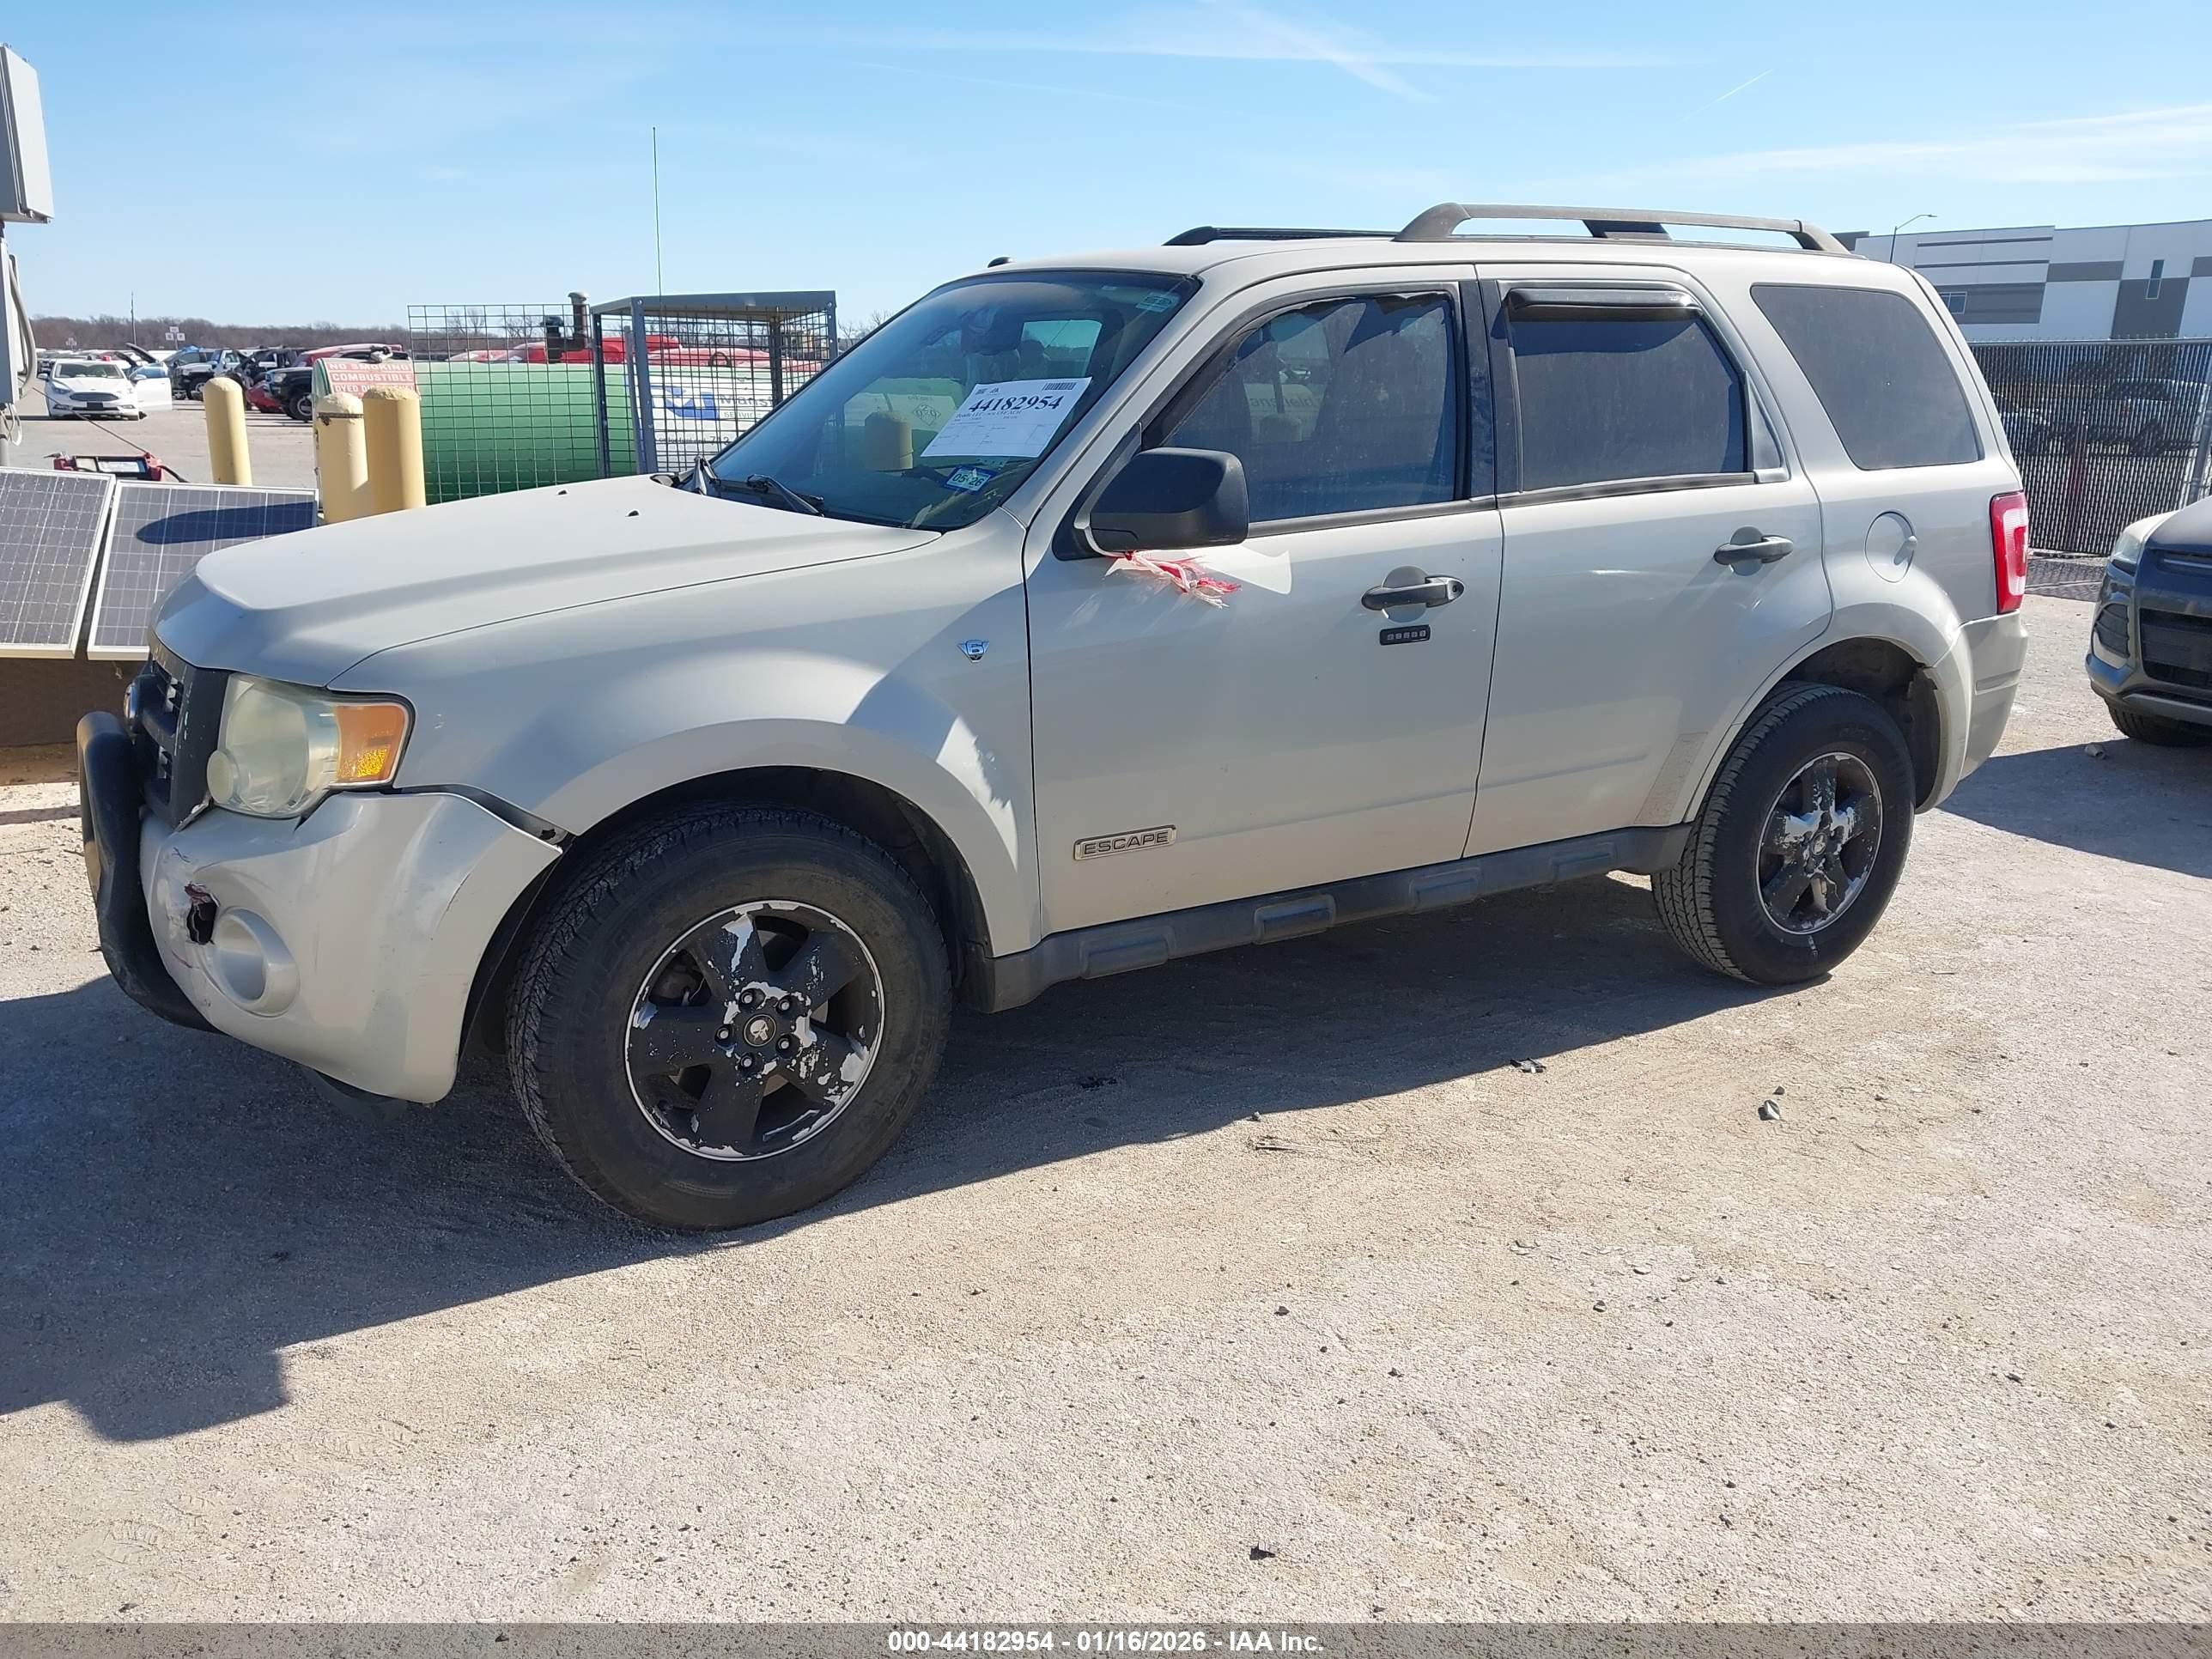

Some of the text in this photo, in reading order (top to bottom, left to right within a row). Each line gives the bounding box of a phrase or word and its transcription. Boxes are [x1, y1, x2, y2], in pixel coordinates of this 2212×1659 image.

[331, 373, 413, 381] COMBUSTIBLE
[969, 394, 1064, 412] 44182954
[968, 477, 985, 487] 26
[1084, 831, 1169, 855] ESCAPE
